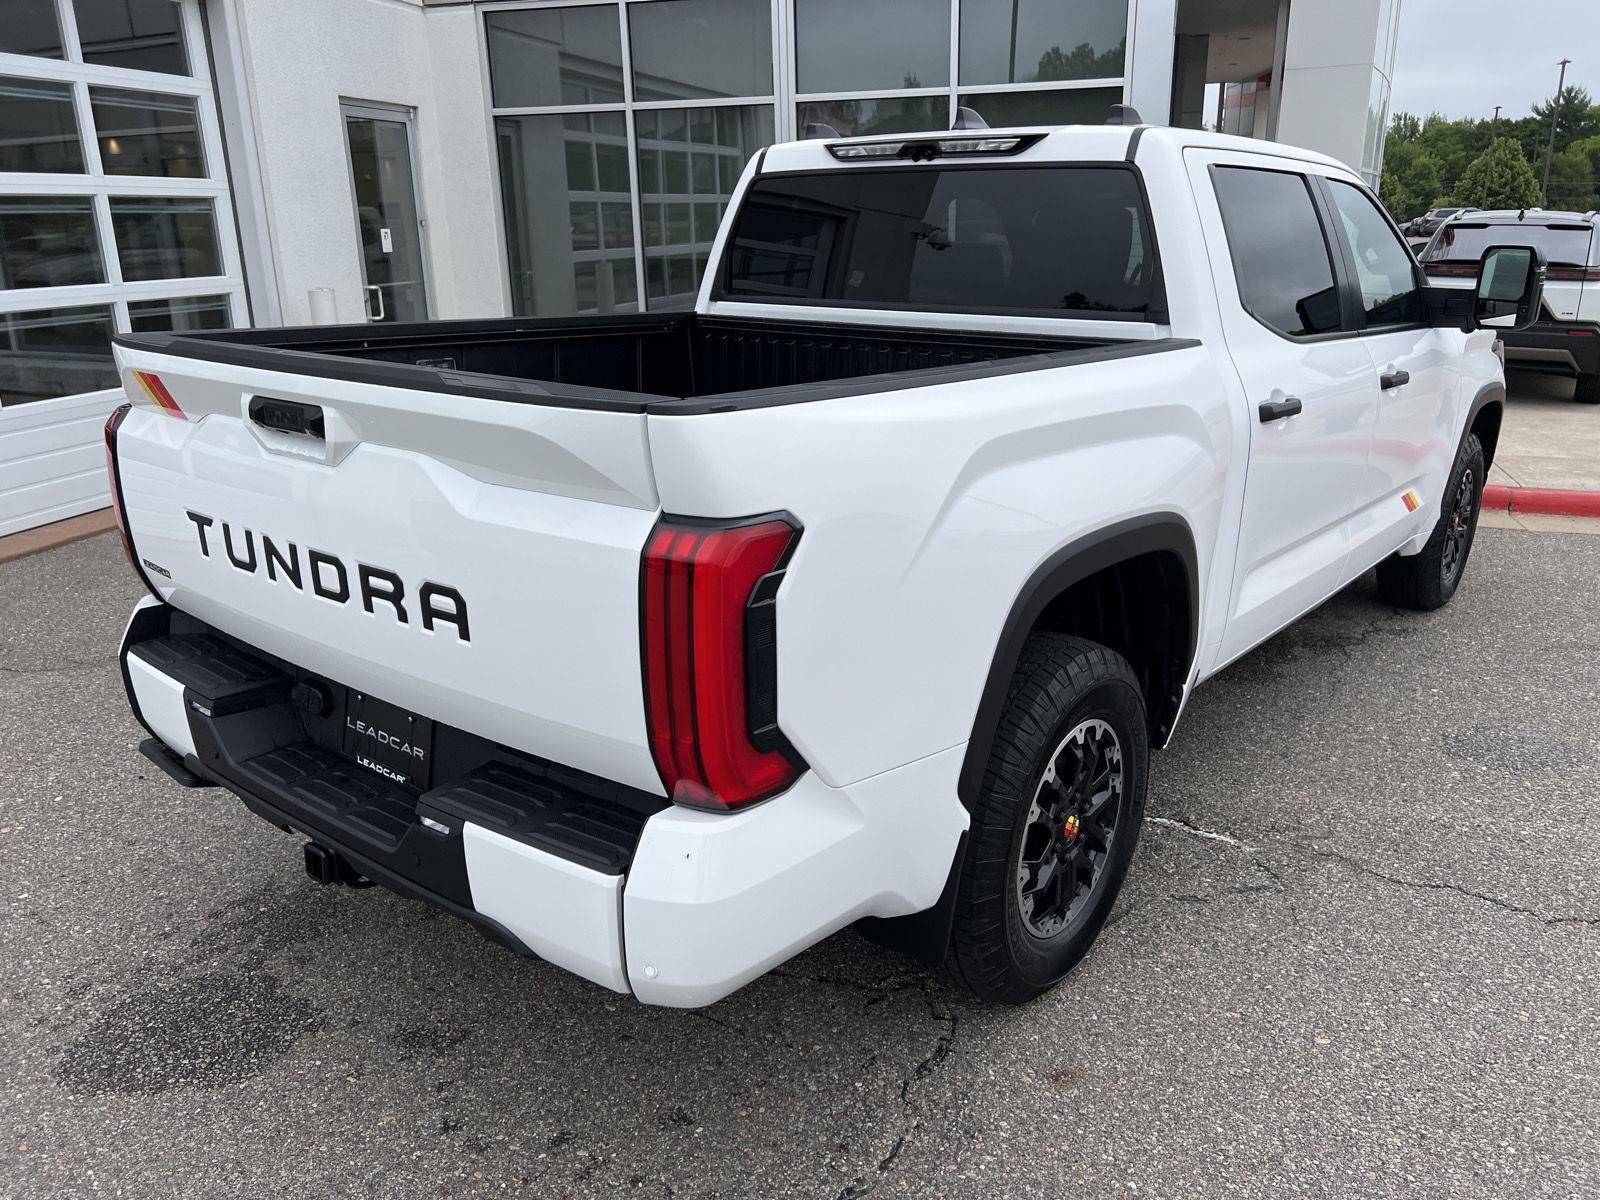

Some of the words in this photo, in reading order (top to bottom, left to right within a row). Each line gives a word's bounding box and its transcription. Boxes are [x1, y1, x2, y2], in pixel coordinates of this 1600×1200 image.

[186, 510, 471, 643] TUNDRA
[346, 715, 424, 761] LEADCAR
[356, 753, 406, 784] LEADCAR
